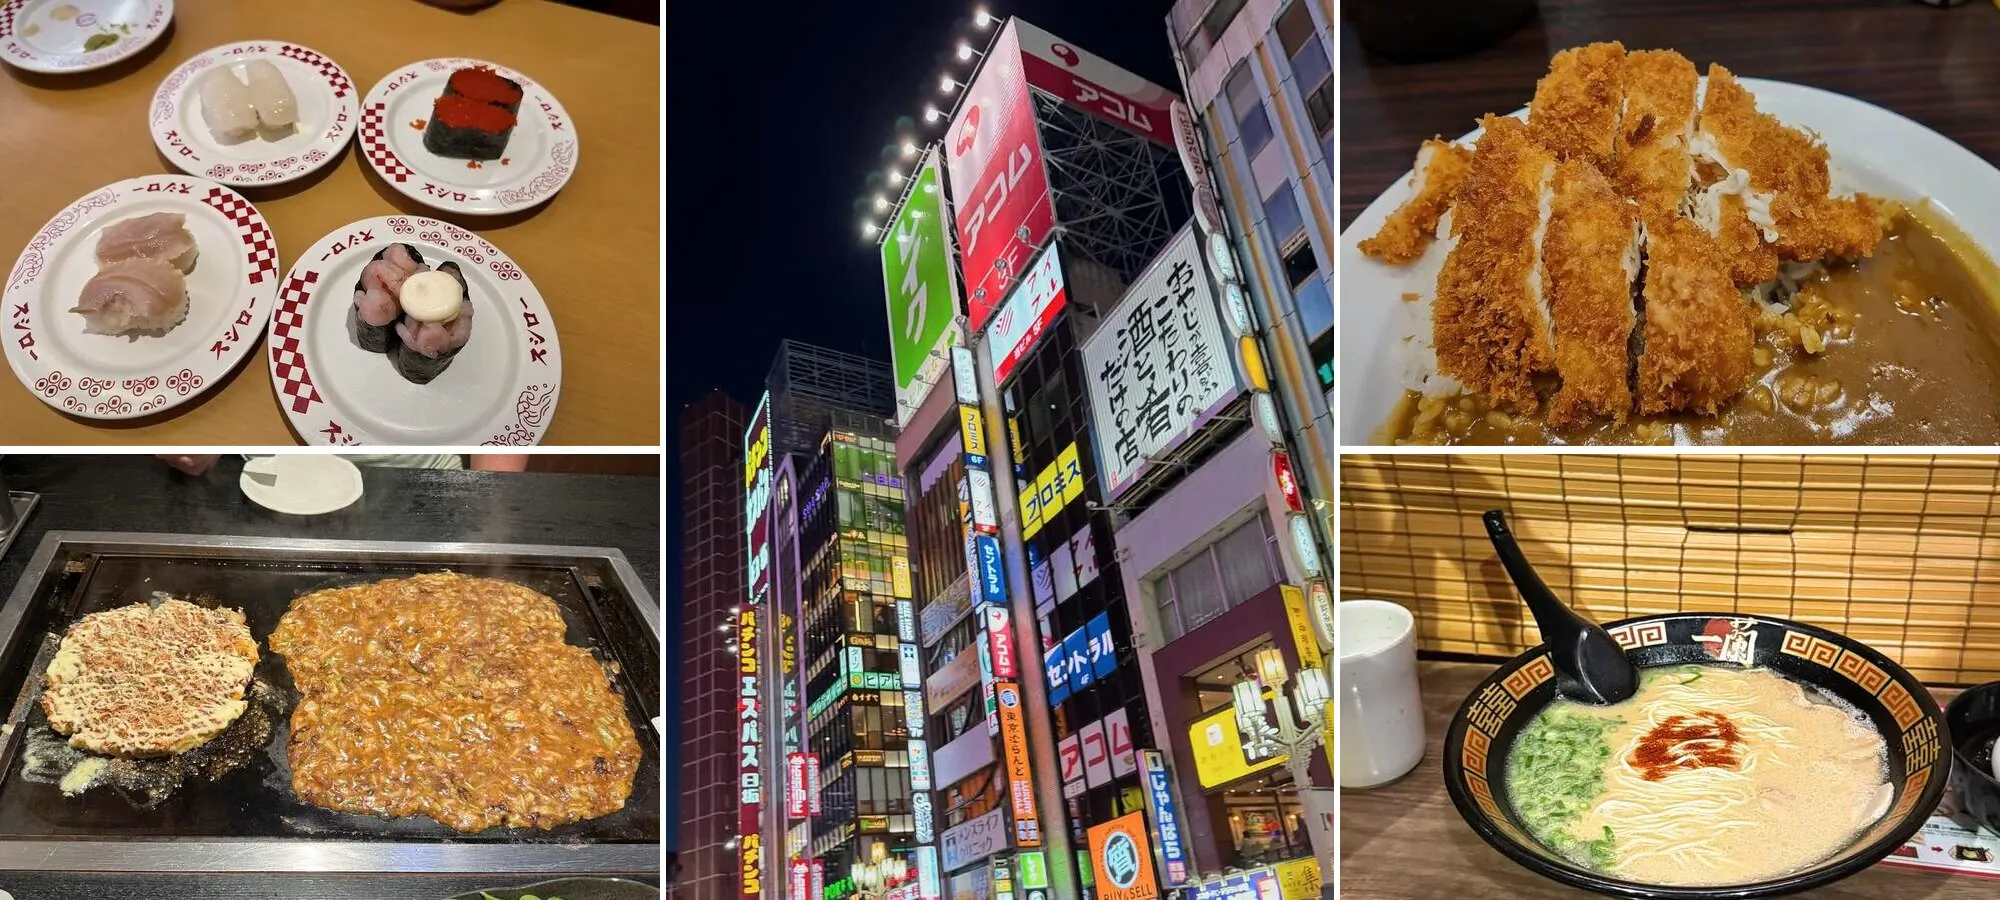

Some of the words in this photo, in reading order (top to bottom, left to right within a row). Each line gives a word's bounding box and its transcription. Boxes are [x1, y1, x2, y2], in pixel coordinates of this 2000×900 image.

[222, 45, 268, 56] スシロー
[383, 71, 419, 96] スシロー
[1072, 79, 1153, 132] アコム
[326, 105, 348, 142] スシロー
[534, 95, 565, 131] スシロー
[164, 129, 201, 161] スシロー
[133, 182, 195, 194] スシロー
[421, 182, 481, 202] スシロー
[964, 142, 1032, 258] アコム
[320, 229, 375, 261] スシロー
[13, 302, 39, 361] スシロー
[210, 297, 257, 360] スシロー
[519, 297, 549, 366] スシロー
[1117, 297, 1172, 442] 酒と肴
[1154, 295, 1194, 416] こだわりの
[1100, 354, 1139, 474] だけの店
[1025, 459, 1082, 520] プロミス
[739, 608, 758, 673] パチンコ
[994, 633, 1011, 666] アコム
[1048, 629, 1115, 688] セントラル
[740, 676, 759, 767] エスパス
[1060, 722, 1133, 779] アコム
[960, 814, 999, 840] メンズライフ
[960, 836, 993, 858] クリニック
[743, 834, 761, 894] パチンコ
[1107, 837, 1137, 882] 質
[1130, 883, 1153, 899] SELL
